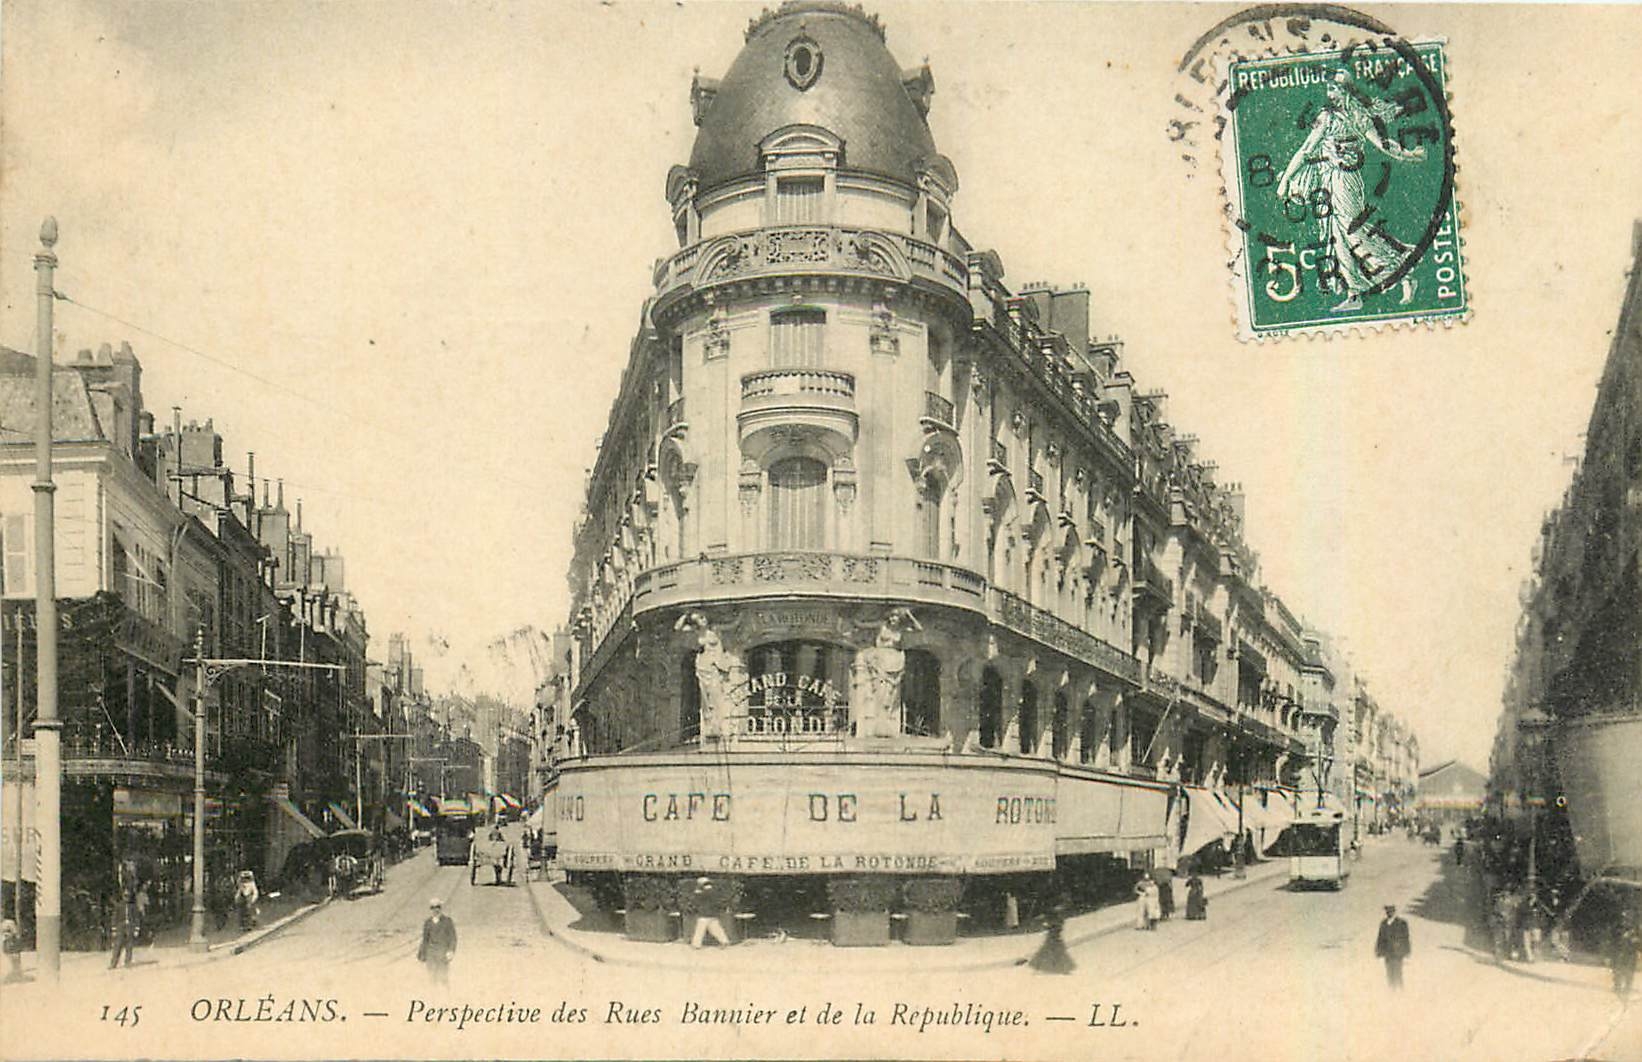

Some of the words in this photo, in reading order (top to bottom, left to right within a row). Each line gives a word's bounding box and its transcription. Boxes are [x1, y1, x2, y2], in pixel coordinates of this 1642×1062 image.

[643, 793, 732, 822] CAFE
[808, 793, 857, 822] DE
[899, 793, 944, 822] LA
[636, 855, 692, 868] GRAND
[786, 857, 809, 868] DE
[821, 857, 843, 868] LA
[855, 857, 937, 869] ROTONDE
